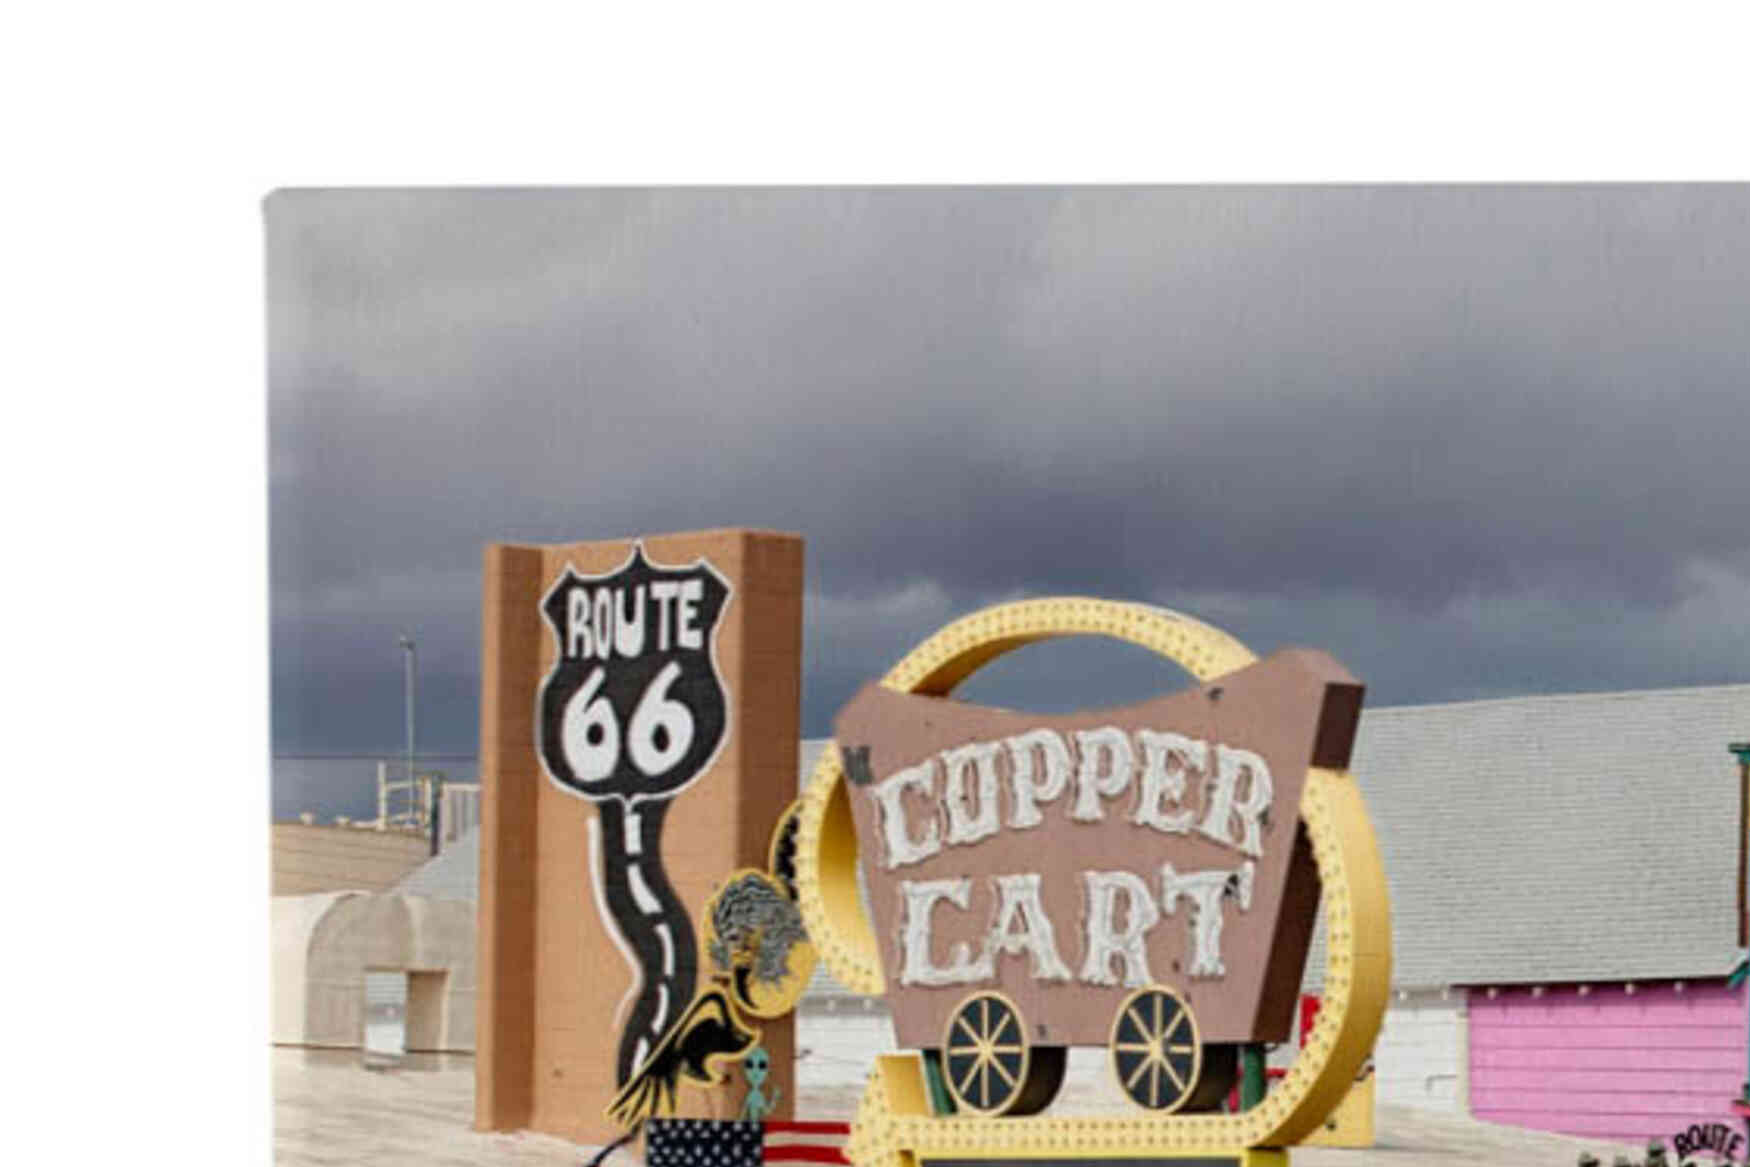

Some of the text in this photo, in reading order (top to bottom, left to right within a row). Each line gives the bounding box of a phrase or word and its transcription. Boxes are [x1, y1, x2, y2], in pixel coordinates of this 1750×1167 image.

[567, 581, 703, 659] ROUTE
[562, 661, 695, 782] 66
[871, 726, 1273, 869] COPPER
[900, 861, 1255, 987] CART
[1674, 1123, 1745, 1160] ROUTE
